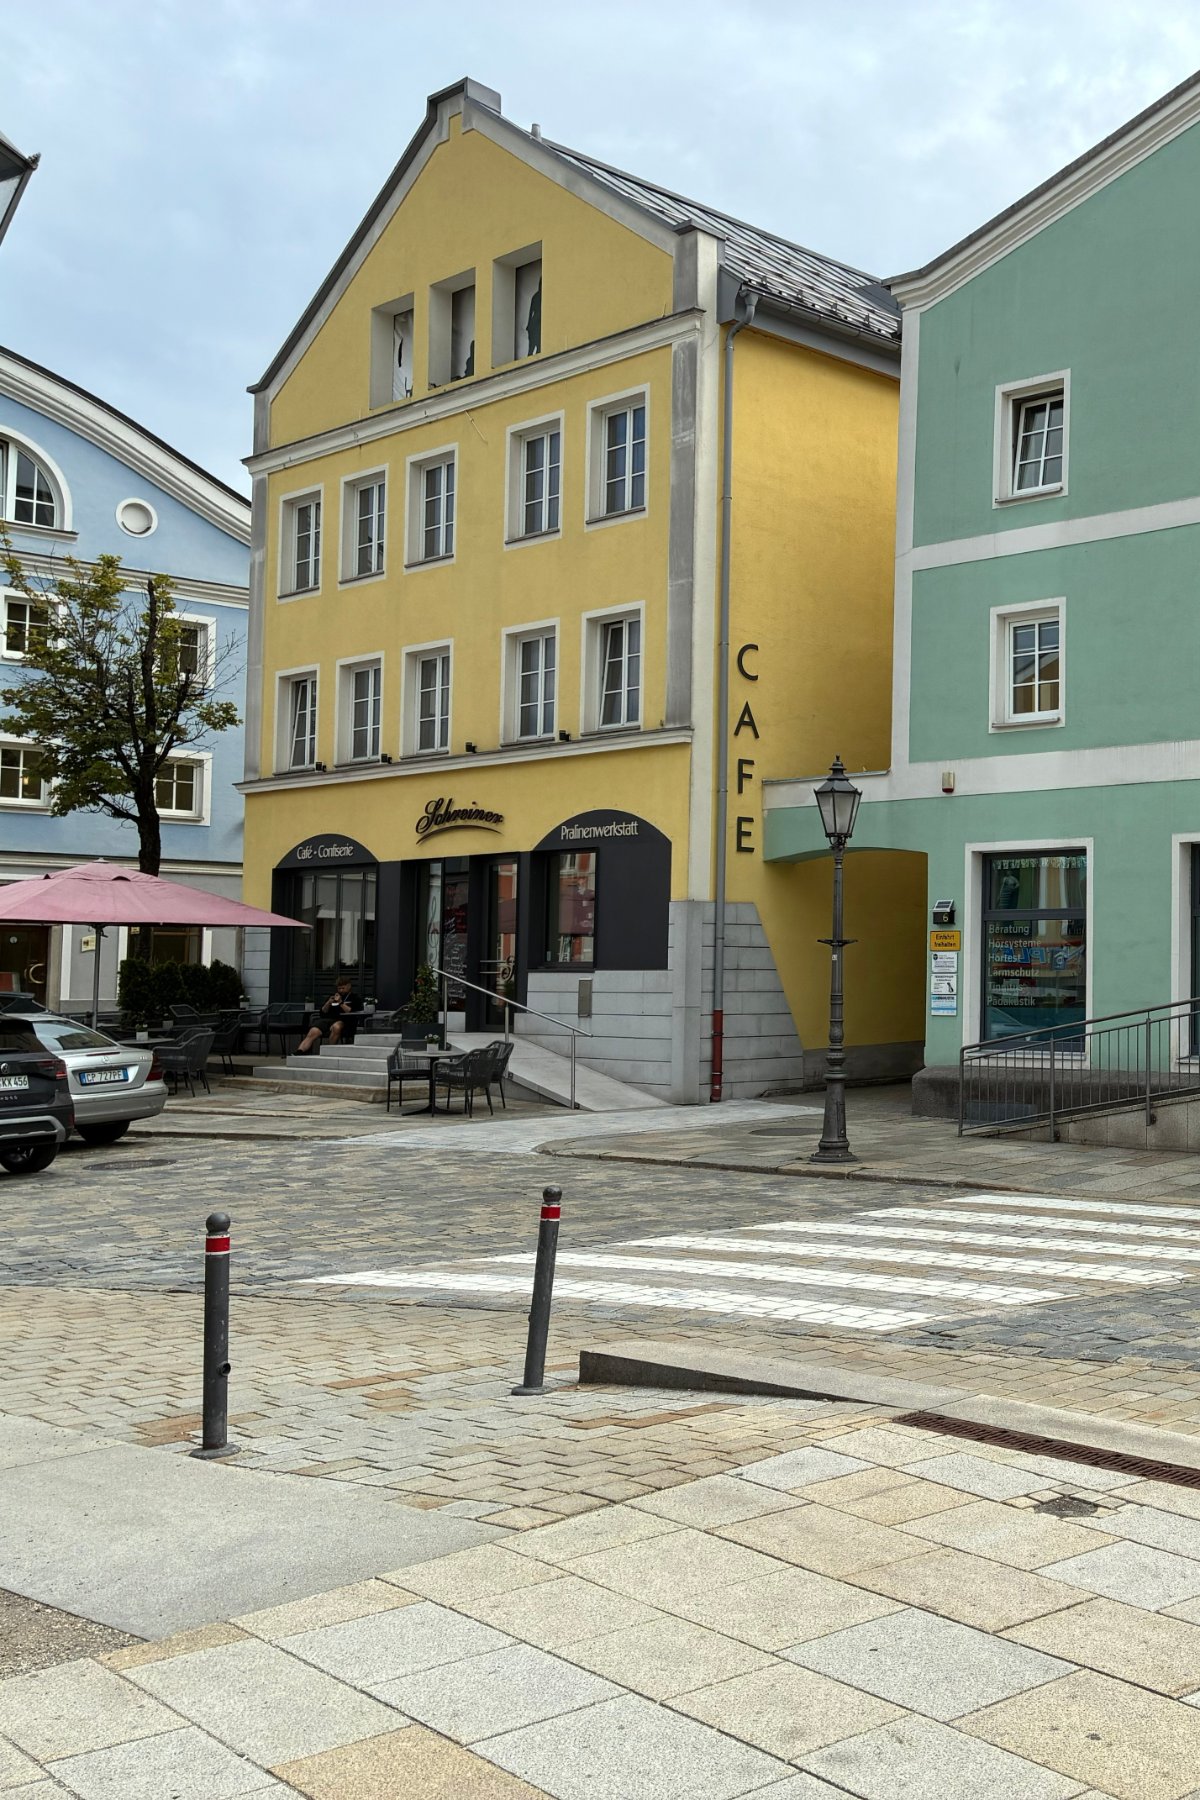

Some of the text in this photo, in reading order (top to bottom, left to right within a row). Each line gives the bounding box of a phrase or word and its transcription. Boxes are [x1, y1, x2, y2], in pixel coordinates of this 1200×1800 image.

[733, 643, 760, 853] CAFE
[415, 797, 505, 834] Schreiner
[560, 820, 639, 841] Pralinenwerkstatt
[296, 843, 354, 860] Café Confiserie
[942, 912, 949, 922] 6
[988, 924, 1030, 935] Beratung
[988, 938, 1041, 951] Hörsysteme
[987, 967, 1040, 977] Lärmschutz
[14, 1076, 28, 1087] 456
